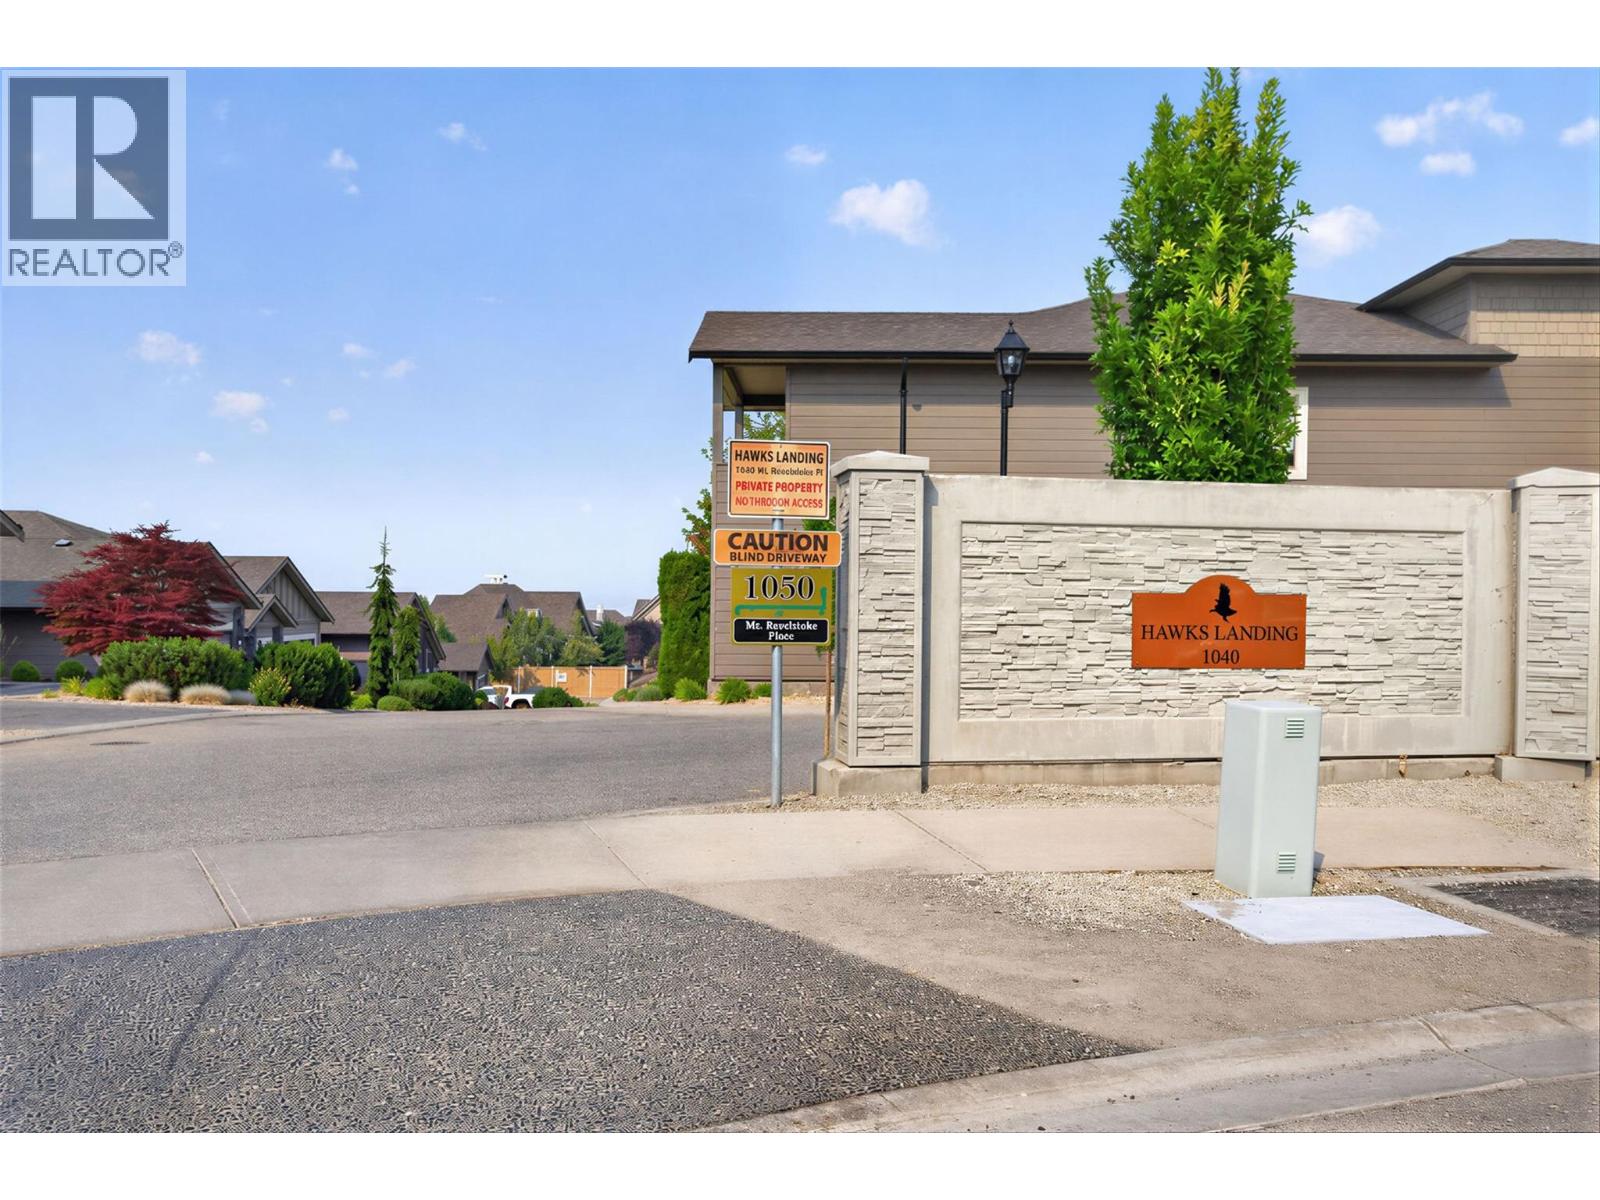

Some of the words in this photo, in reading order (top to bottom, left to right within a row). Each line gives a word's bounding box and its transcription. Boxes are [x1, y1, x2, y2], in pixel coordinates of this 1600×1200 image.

[735, 450, 774, 462] HAWKS
[776, 451, 824, 464] LANDING
[735, 480, 773, 492] PRIVATE
[775, 481, 823, 493] PROPERTY
[735, 497, 749, 506] NO
[792, 498, 823, 509] ACCESS
[727, 532, 829, 551] CAUTION
[729, 552, 764, 562] BLIND
[766, 553, 827, 563] DRIVEWAY
[744, 574, 816, 600] 1050
[1141, 624, 1209, 641] HAWKS
[1214, 625, 1299, 642] LANDING
[1202, 649, 1240, 665] 1040
